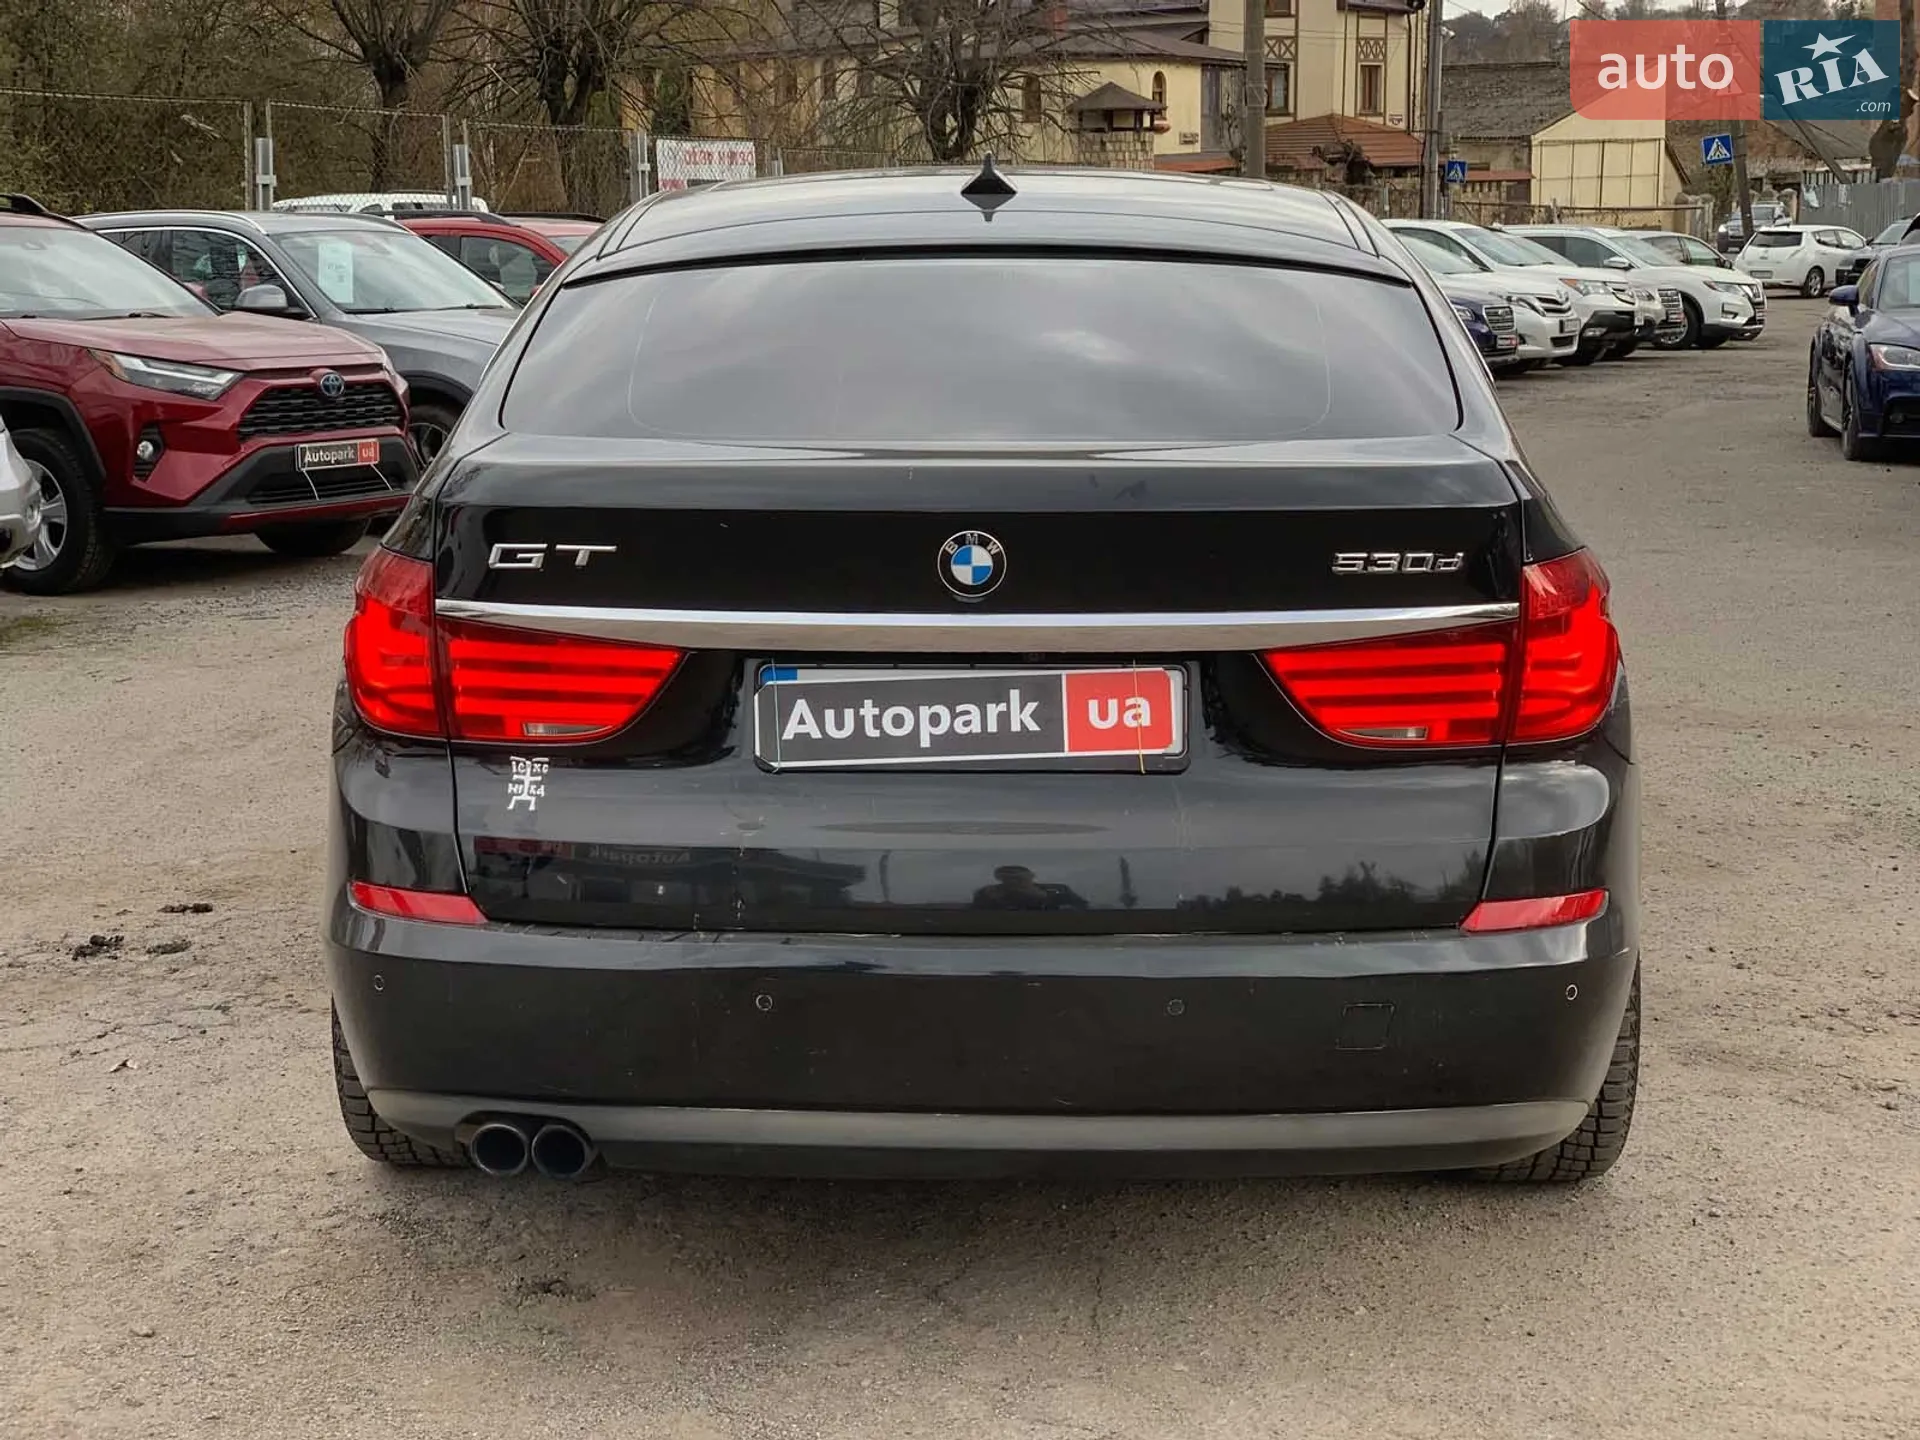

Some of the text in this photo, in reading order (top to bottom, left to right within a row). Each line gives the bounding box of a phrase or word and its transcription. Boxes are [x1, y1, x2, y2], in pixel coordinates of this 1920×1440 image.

[305, 445, 375, 464] Autopark ua
[488, 543, 617, 569] GT
[944, 532, 1000, 556] BMW
[1332, 552, 1464, 573] 530d
[782, 688, 1152, 748] Autopark ua
